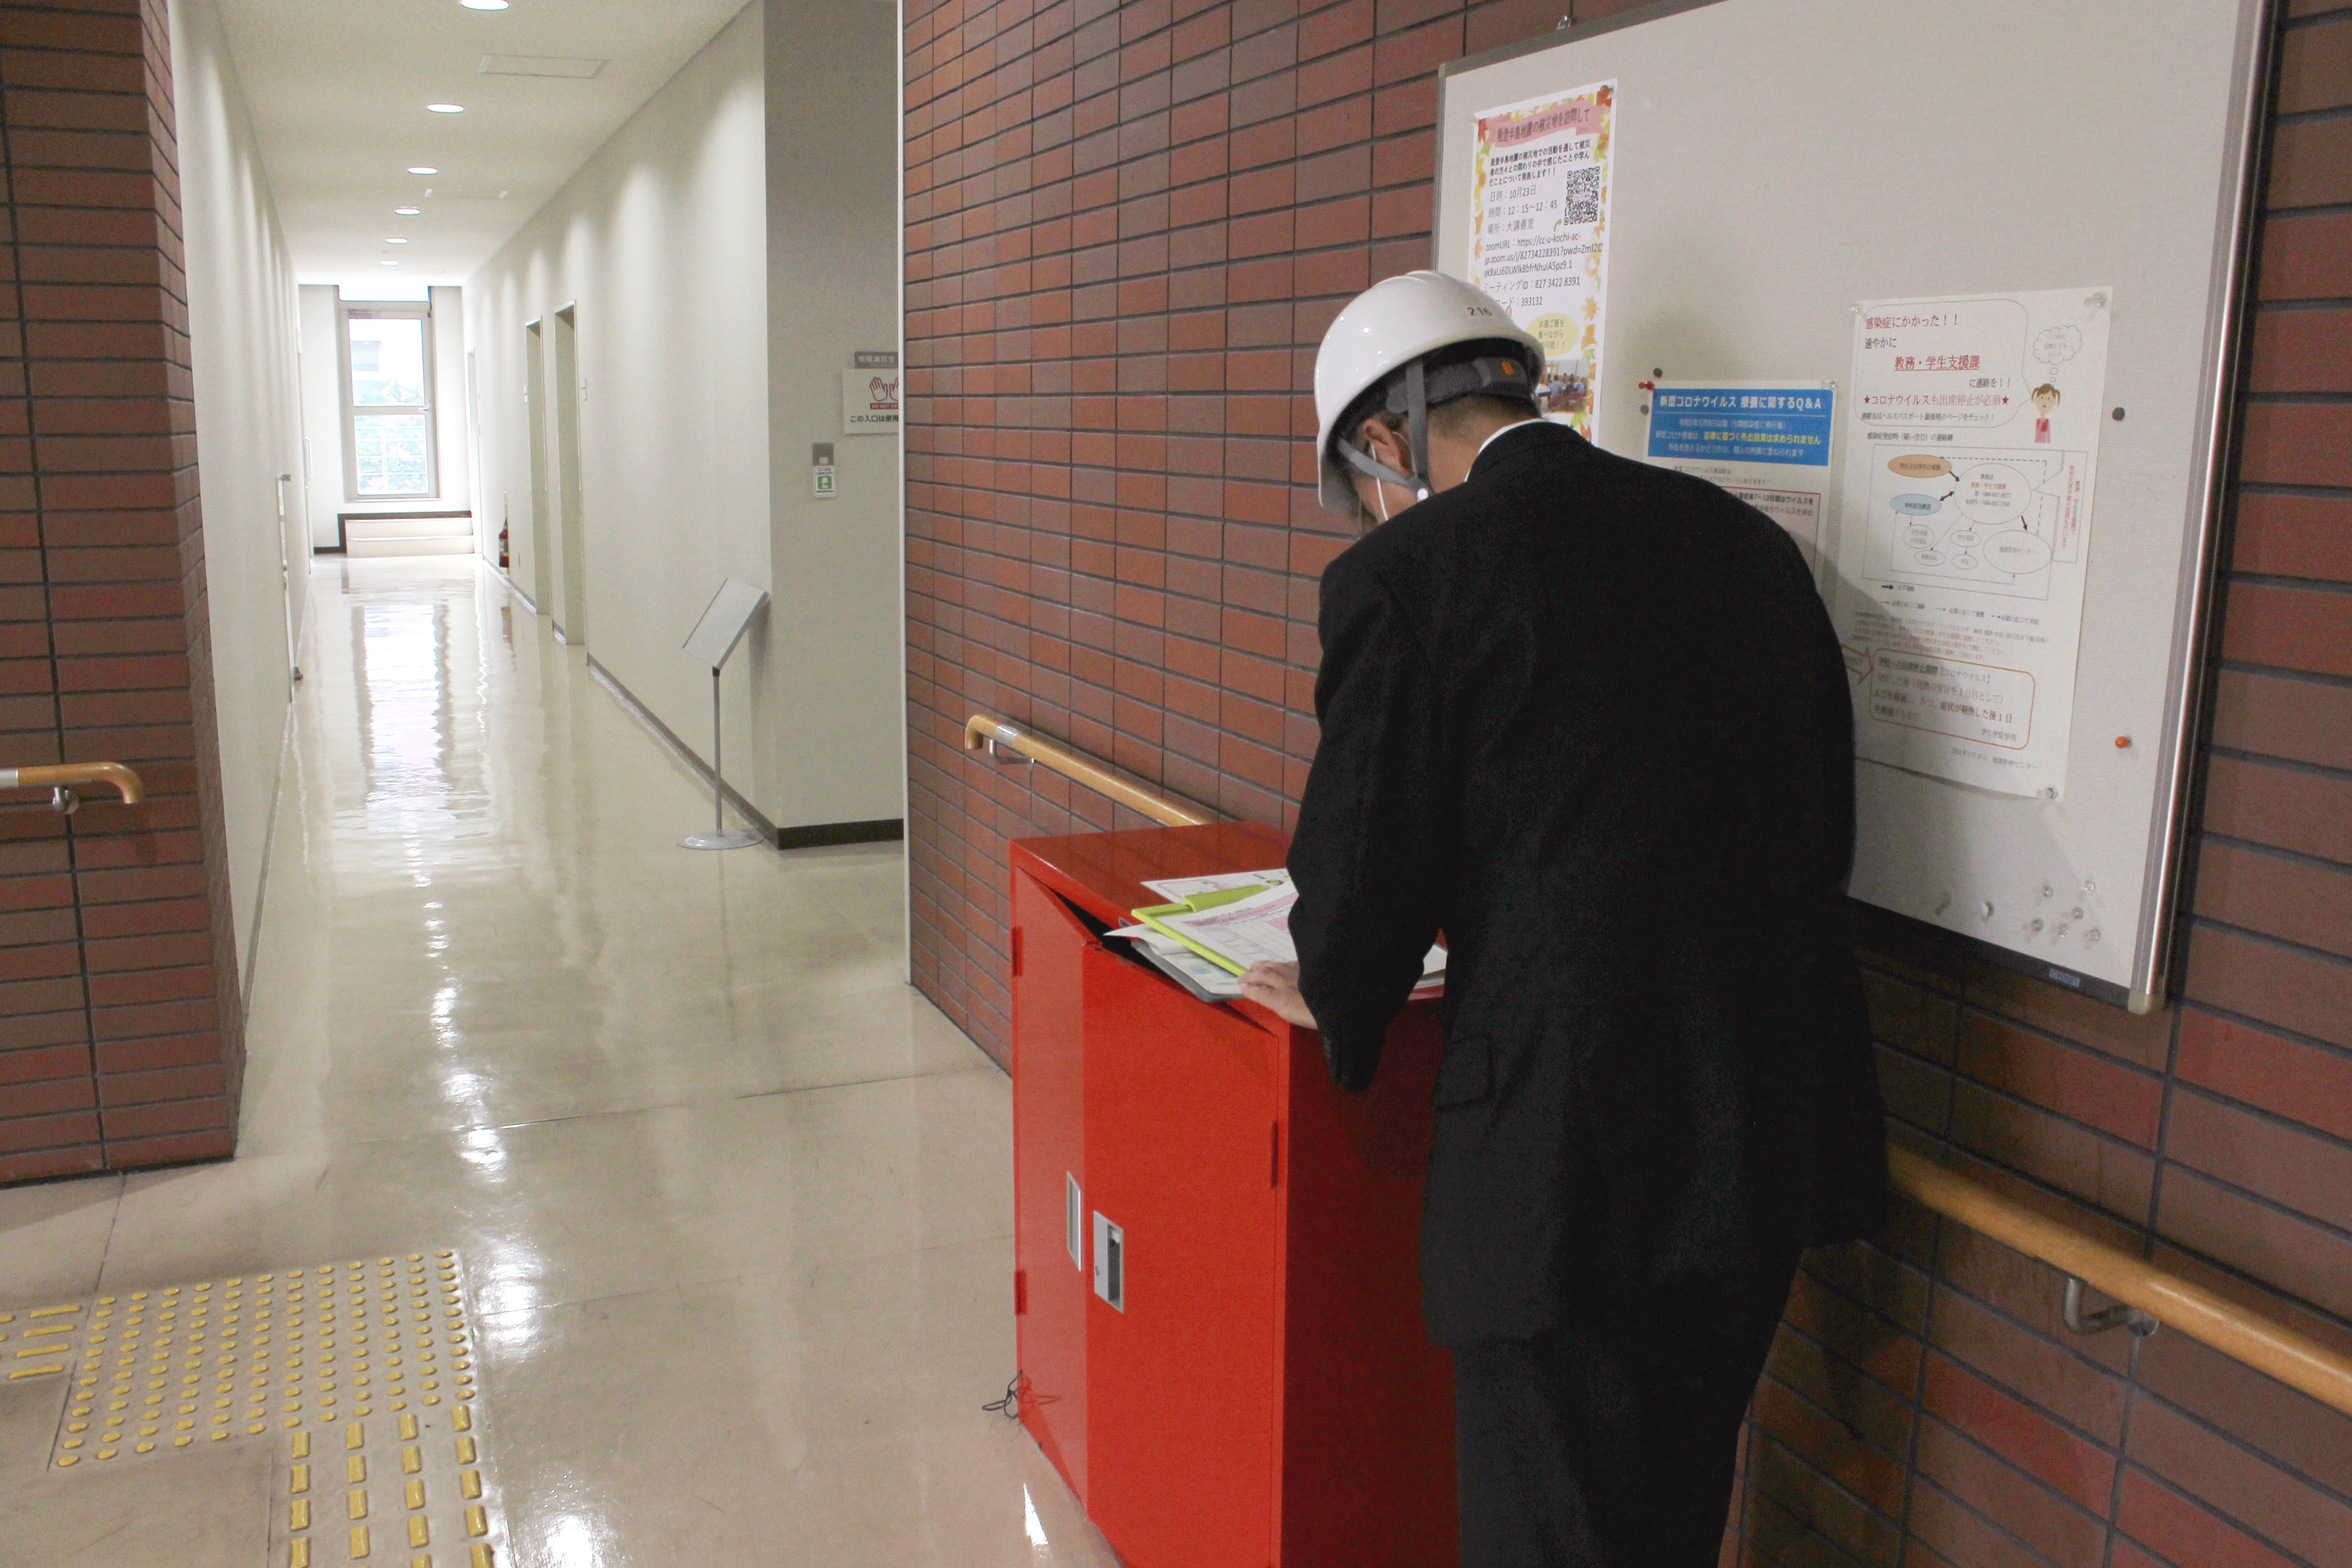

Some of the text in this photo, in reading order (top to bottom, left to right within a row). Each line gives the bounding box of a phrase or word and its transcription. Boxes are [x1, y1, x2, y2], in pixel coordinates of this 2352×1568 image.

[1498, 107, 1589, 142] 能登半島地震の被災地を訪問して
[1490, 139, 1590, 166] 能登半島地震の被災地での活動を通して被災
[1490, 151, 1589, 176] 者の方々との関わりの中で感じたことや学ん
[1488, 219, 1534, 235] 場所：大講義室
[1548, 278, 1563, 287] 3422
[1564, 277, 1580, 286] 8391
[1866, 314, 1957, 329] 感染症にかかった！！
[1865, 337, 1897, 349] 速やかに
[1894, 355, 1980, 369] 教務・学生支援課
[1659, 395, 1736, 407] 新型コロナウイルス
